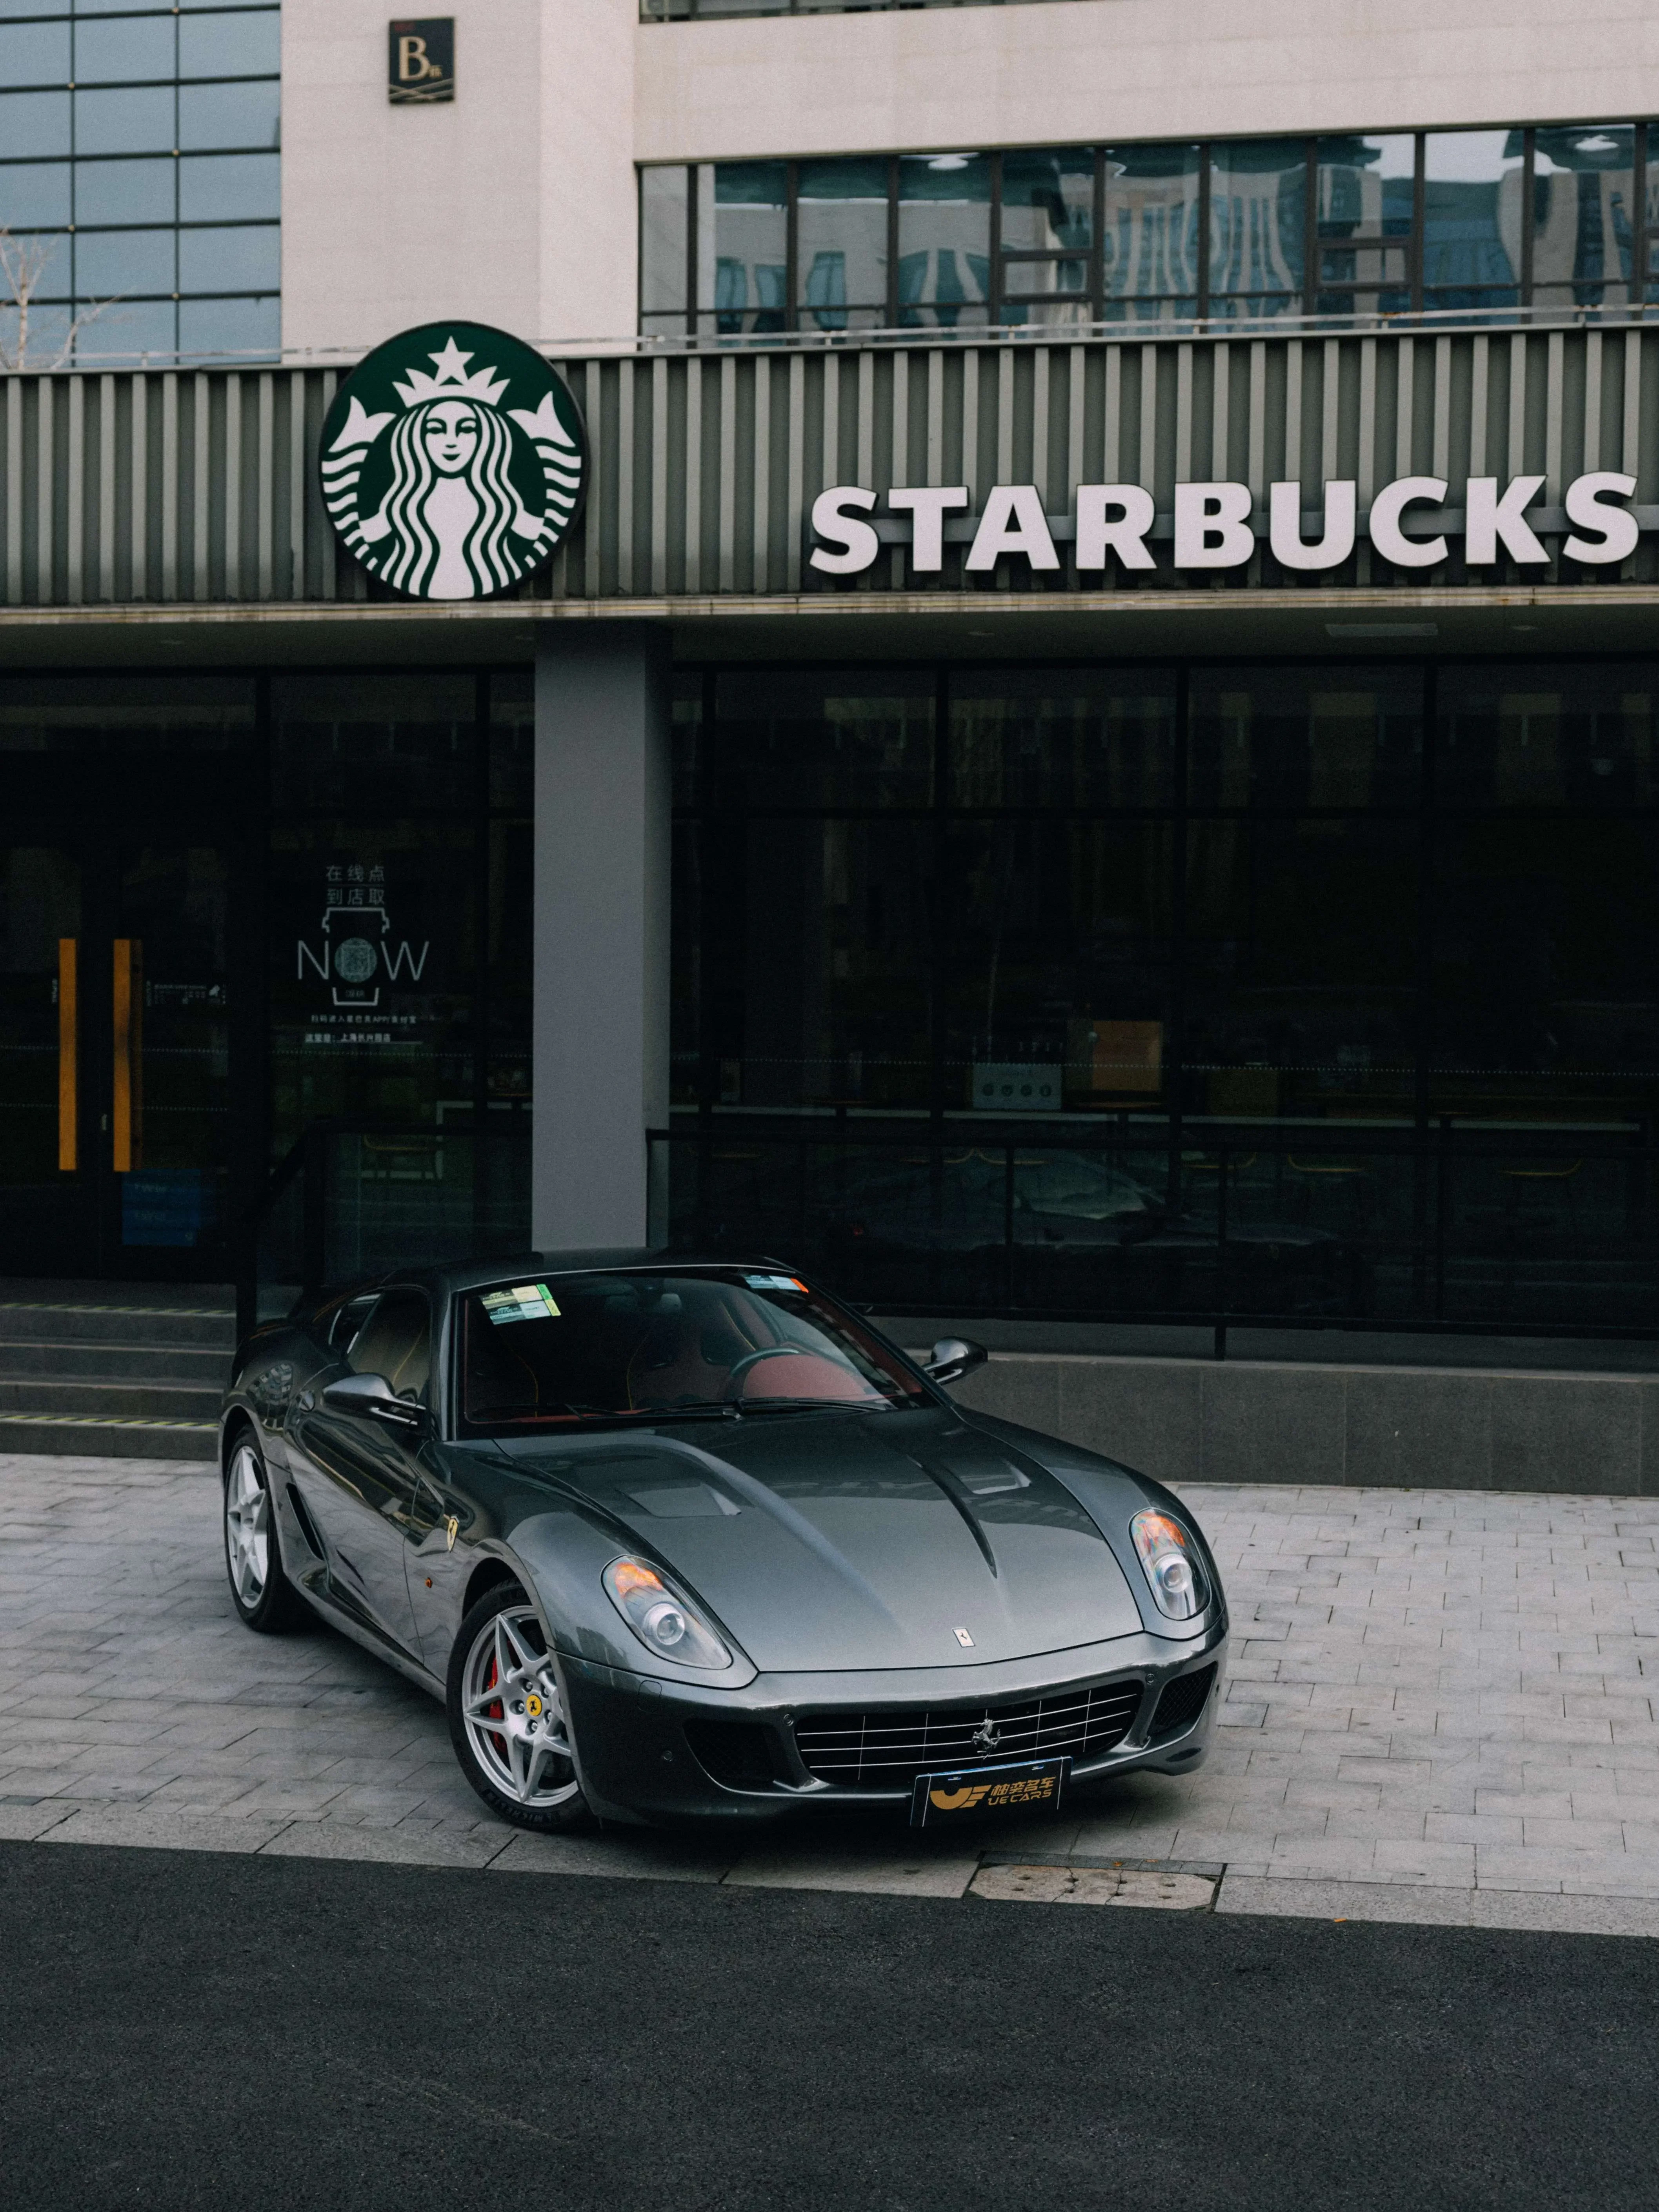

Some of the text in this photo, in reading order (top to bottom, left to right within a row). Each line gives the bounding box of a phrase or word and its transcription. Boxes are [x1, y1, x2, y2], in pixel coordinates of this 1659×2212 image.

[809, 471, 1639, 574] STARBUCKS
[326, 865, 385, 882] 在线点
[326, 888, 385, 905] 到店取
[1010, 1789, 1052, 1803] CARS
